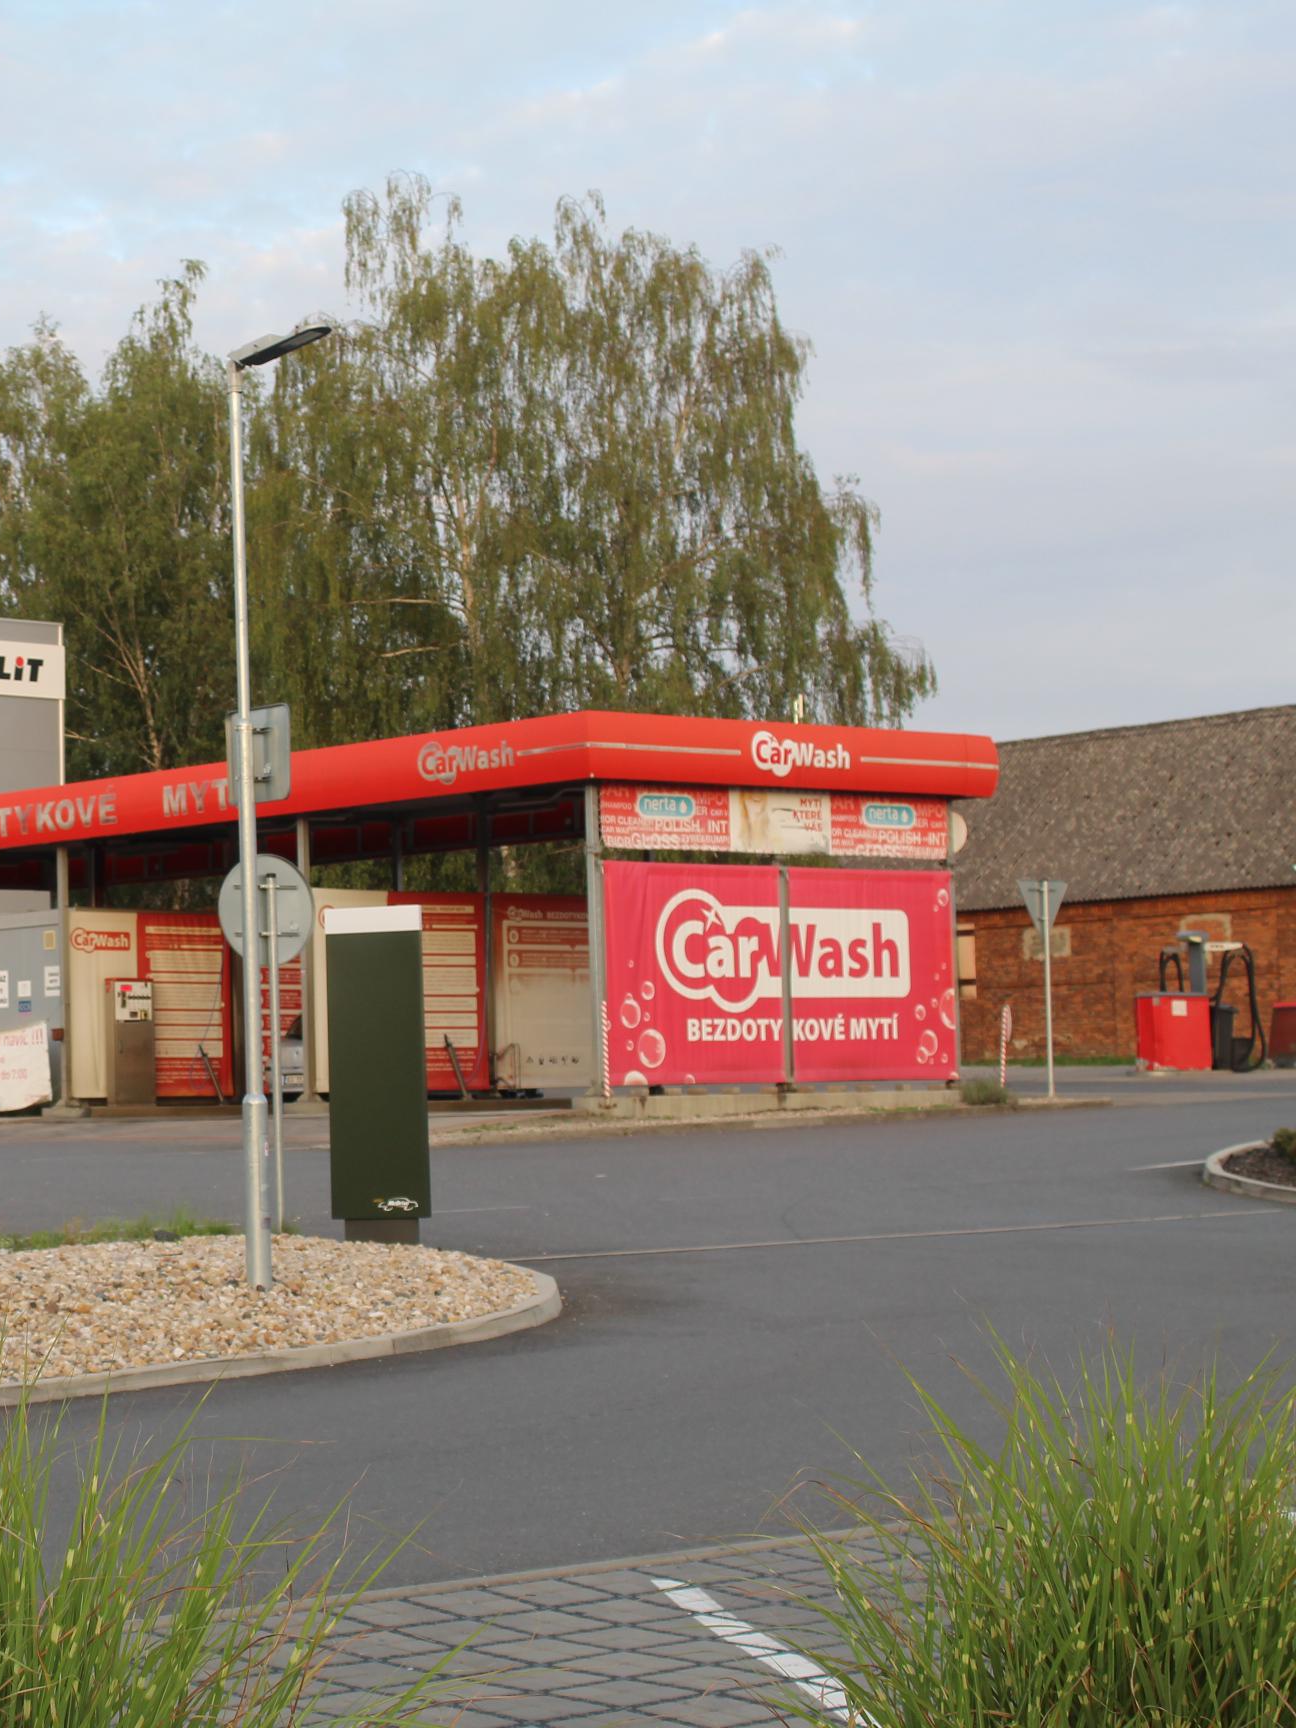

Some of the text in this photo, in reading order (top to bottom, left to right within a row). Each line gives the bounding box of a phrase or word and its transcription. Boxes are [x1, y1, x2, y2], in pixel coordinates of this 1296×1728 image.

[162, 778, 230, 817] MYT
[644, 797, 677, 812] nerta
[869, 807, 899, 820] nerta
[669, 919, 901, 980] CarWash
[850, 1013, 898, 1041] MYTÍ
